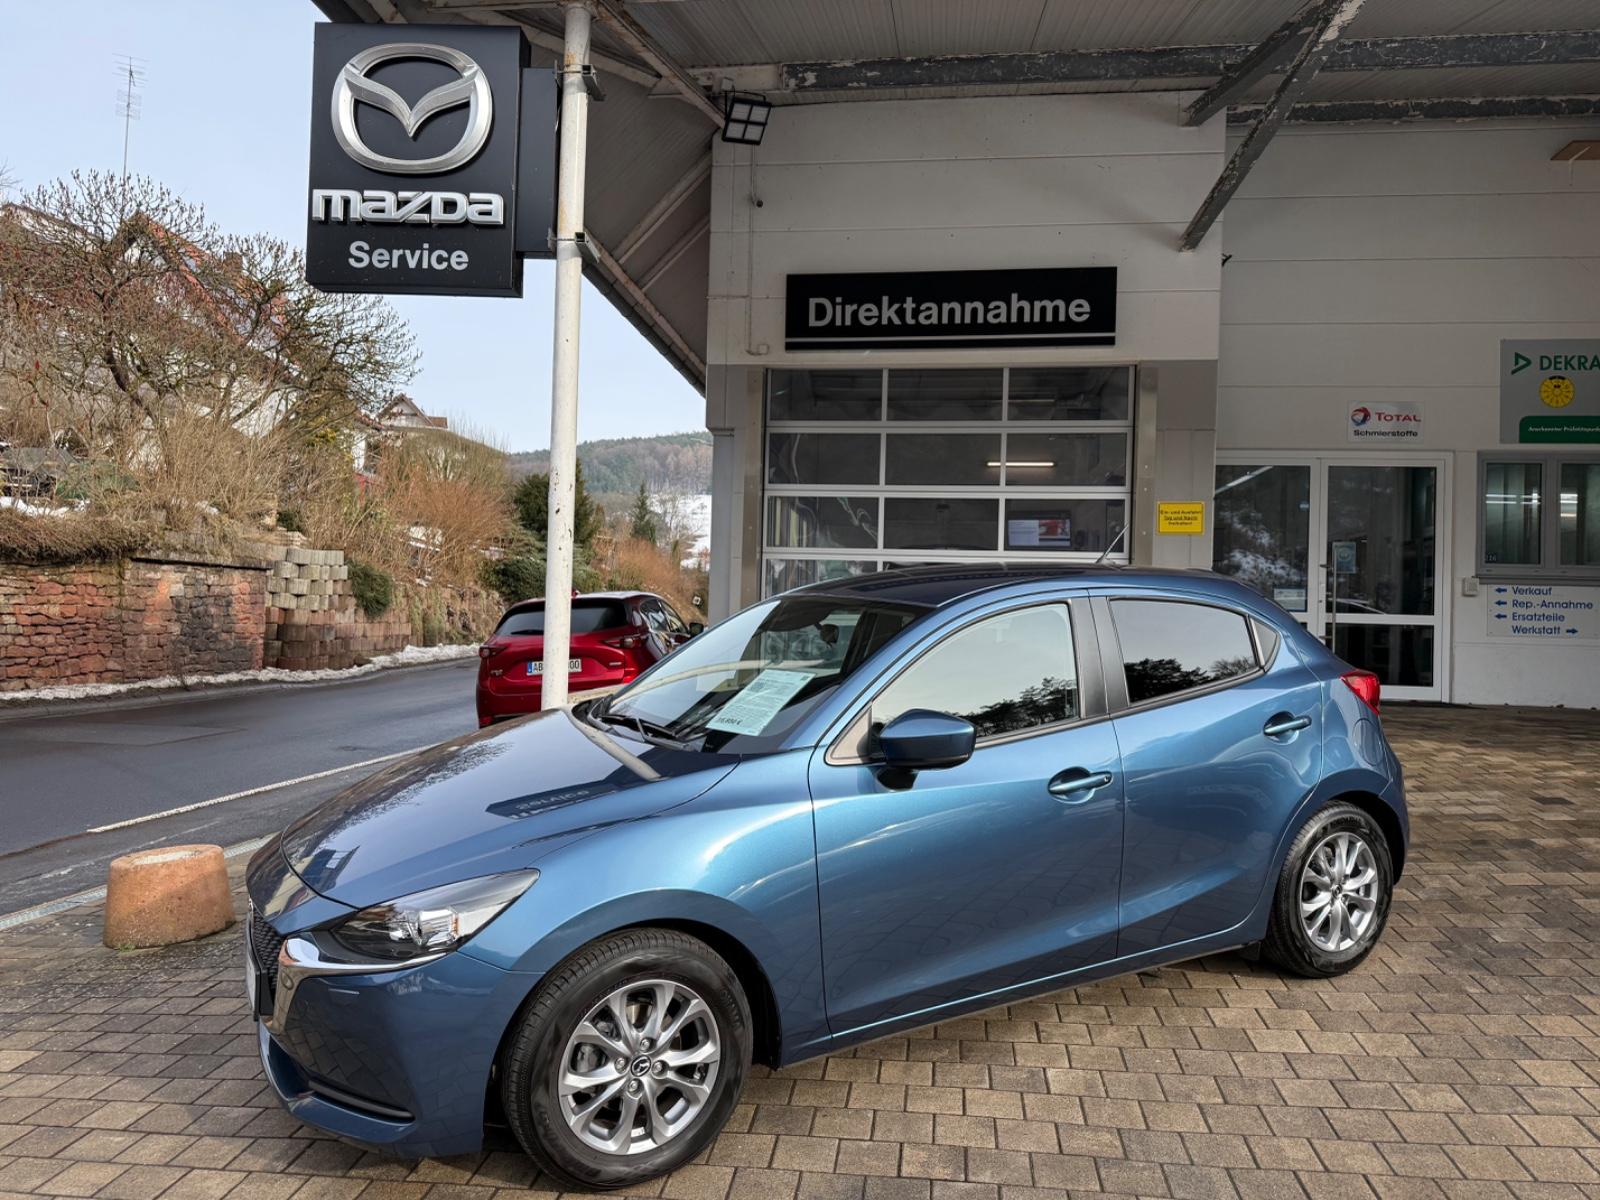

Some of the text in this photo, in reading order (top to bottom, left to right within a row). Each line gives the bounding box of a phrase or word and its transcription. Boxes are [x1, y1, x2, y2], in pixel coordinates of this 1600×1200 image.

[348, 240, 470, 271] Service
[808, 293, 1091, 327] Direktannahme
[1539, 355, 1600, 371] DEKRA
[1353, 429, 1418, 437] Schmierstoffe
[1512, 586, 1553, 596] Verkauf
[1512, 599, 1593, 610] Rep.-Annahme
[1512, 612, 1565, 622] Ersatzteile
[1512, 625, 1561, 635] Werkstatt
